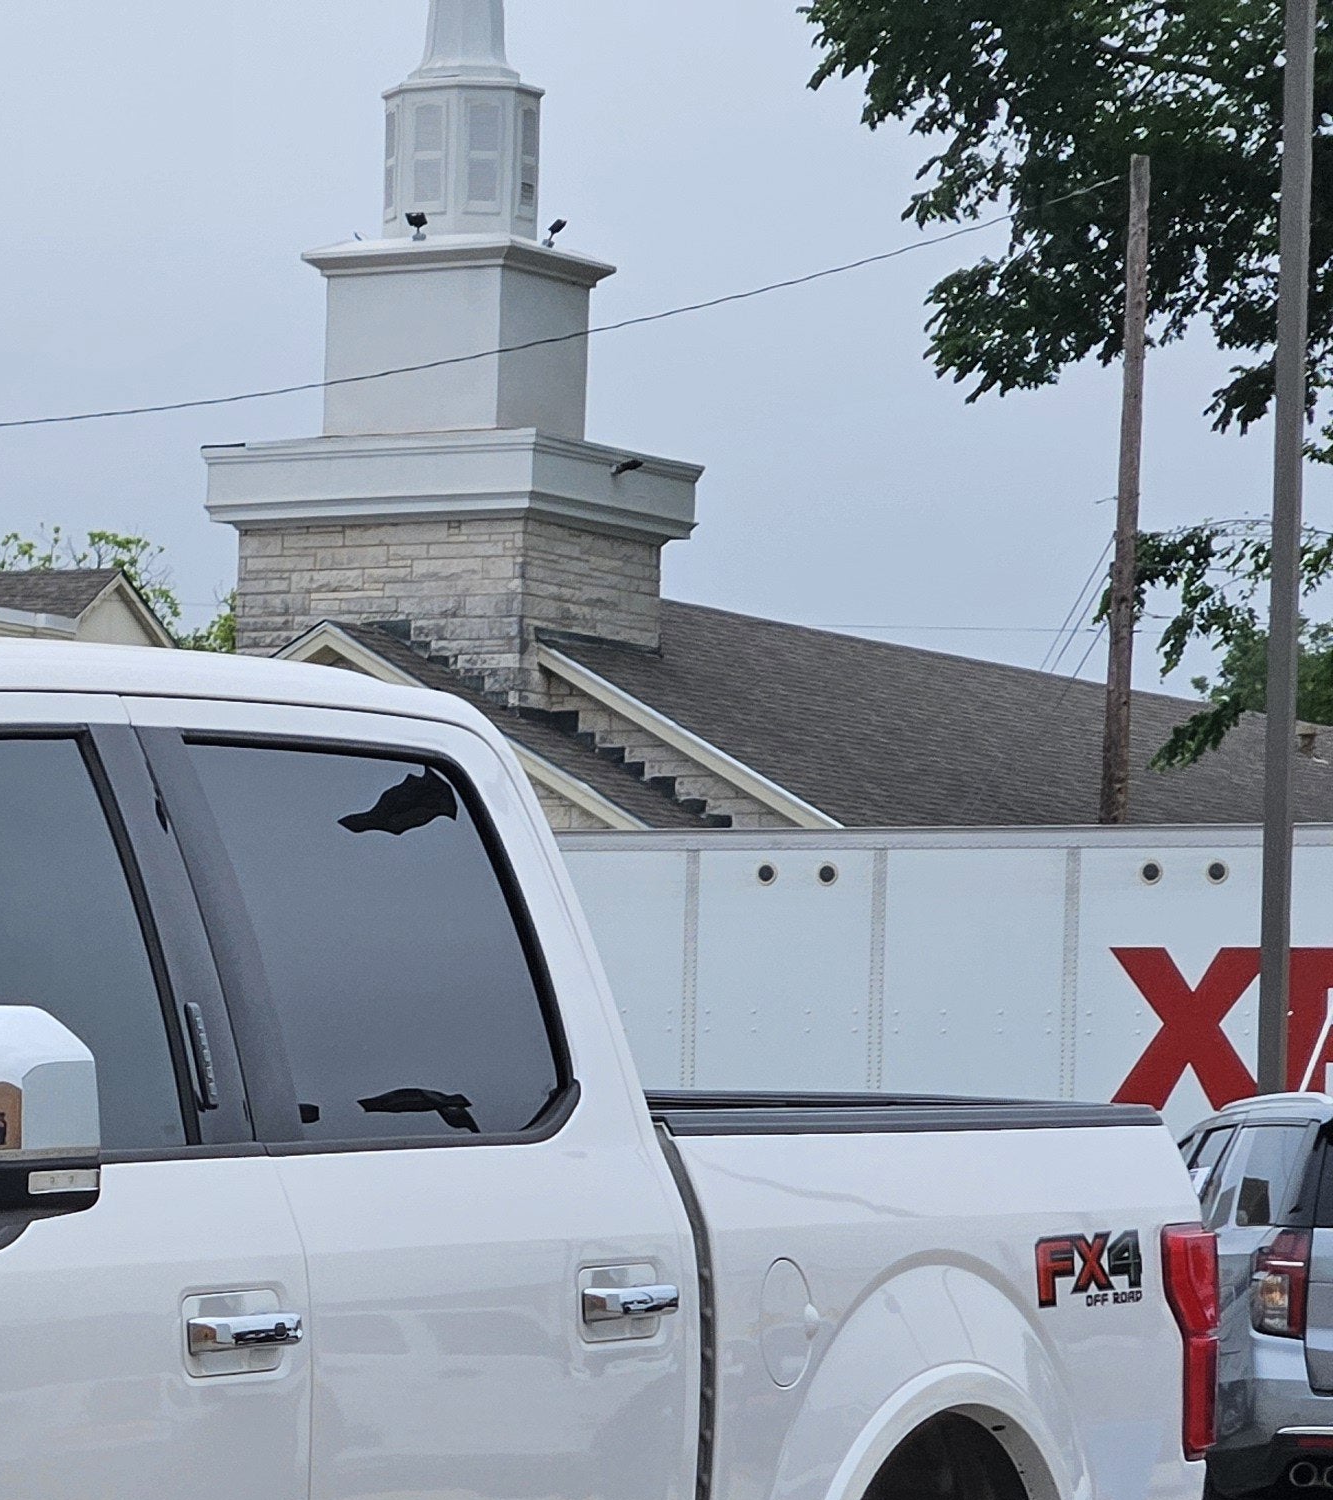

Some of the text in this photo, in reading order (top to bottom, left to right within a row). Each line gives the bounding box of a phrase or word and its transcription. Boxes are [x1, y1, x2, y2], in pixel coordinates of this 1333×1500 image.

[1035, 1229, 1142, 1308] FX4
[1086, 1290, 1142, 1307] OFF ROAD
